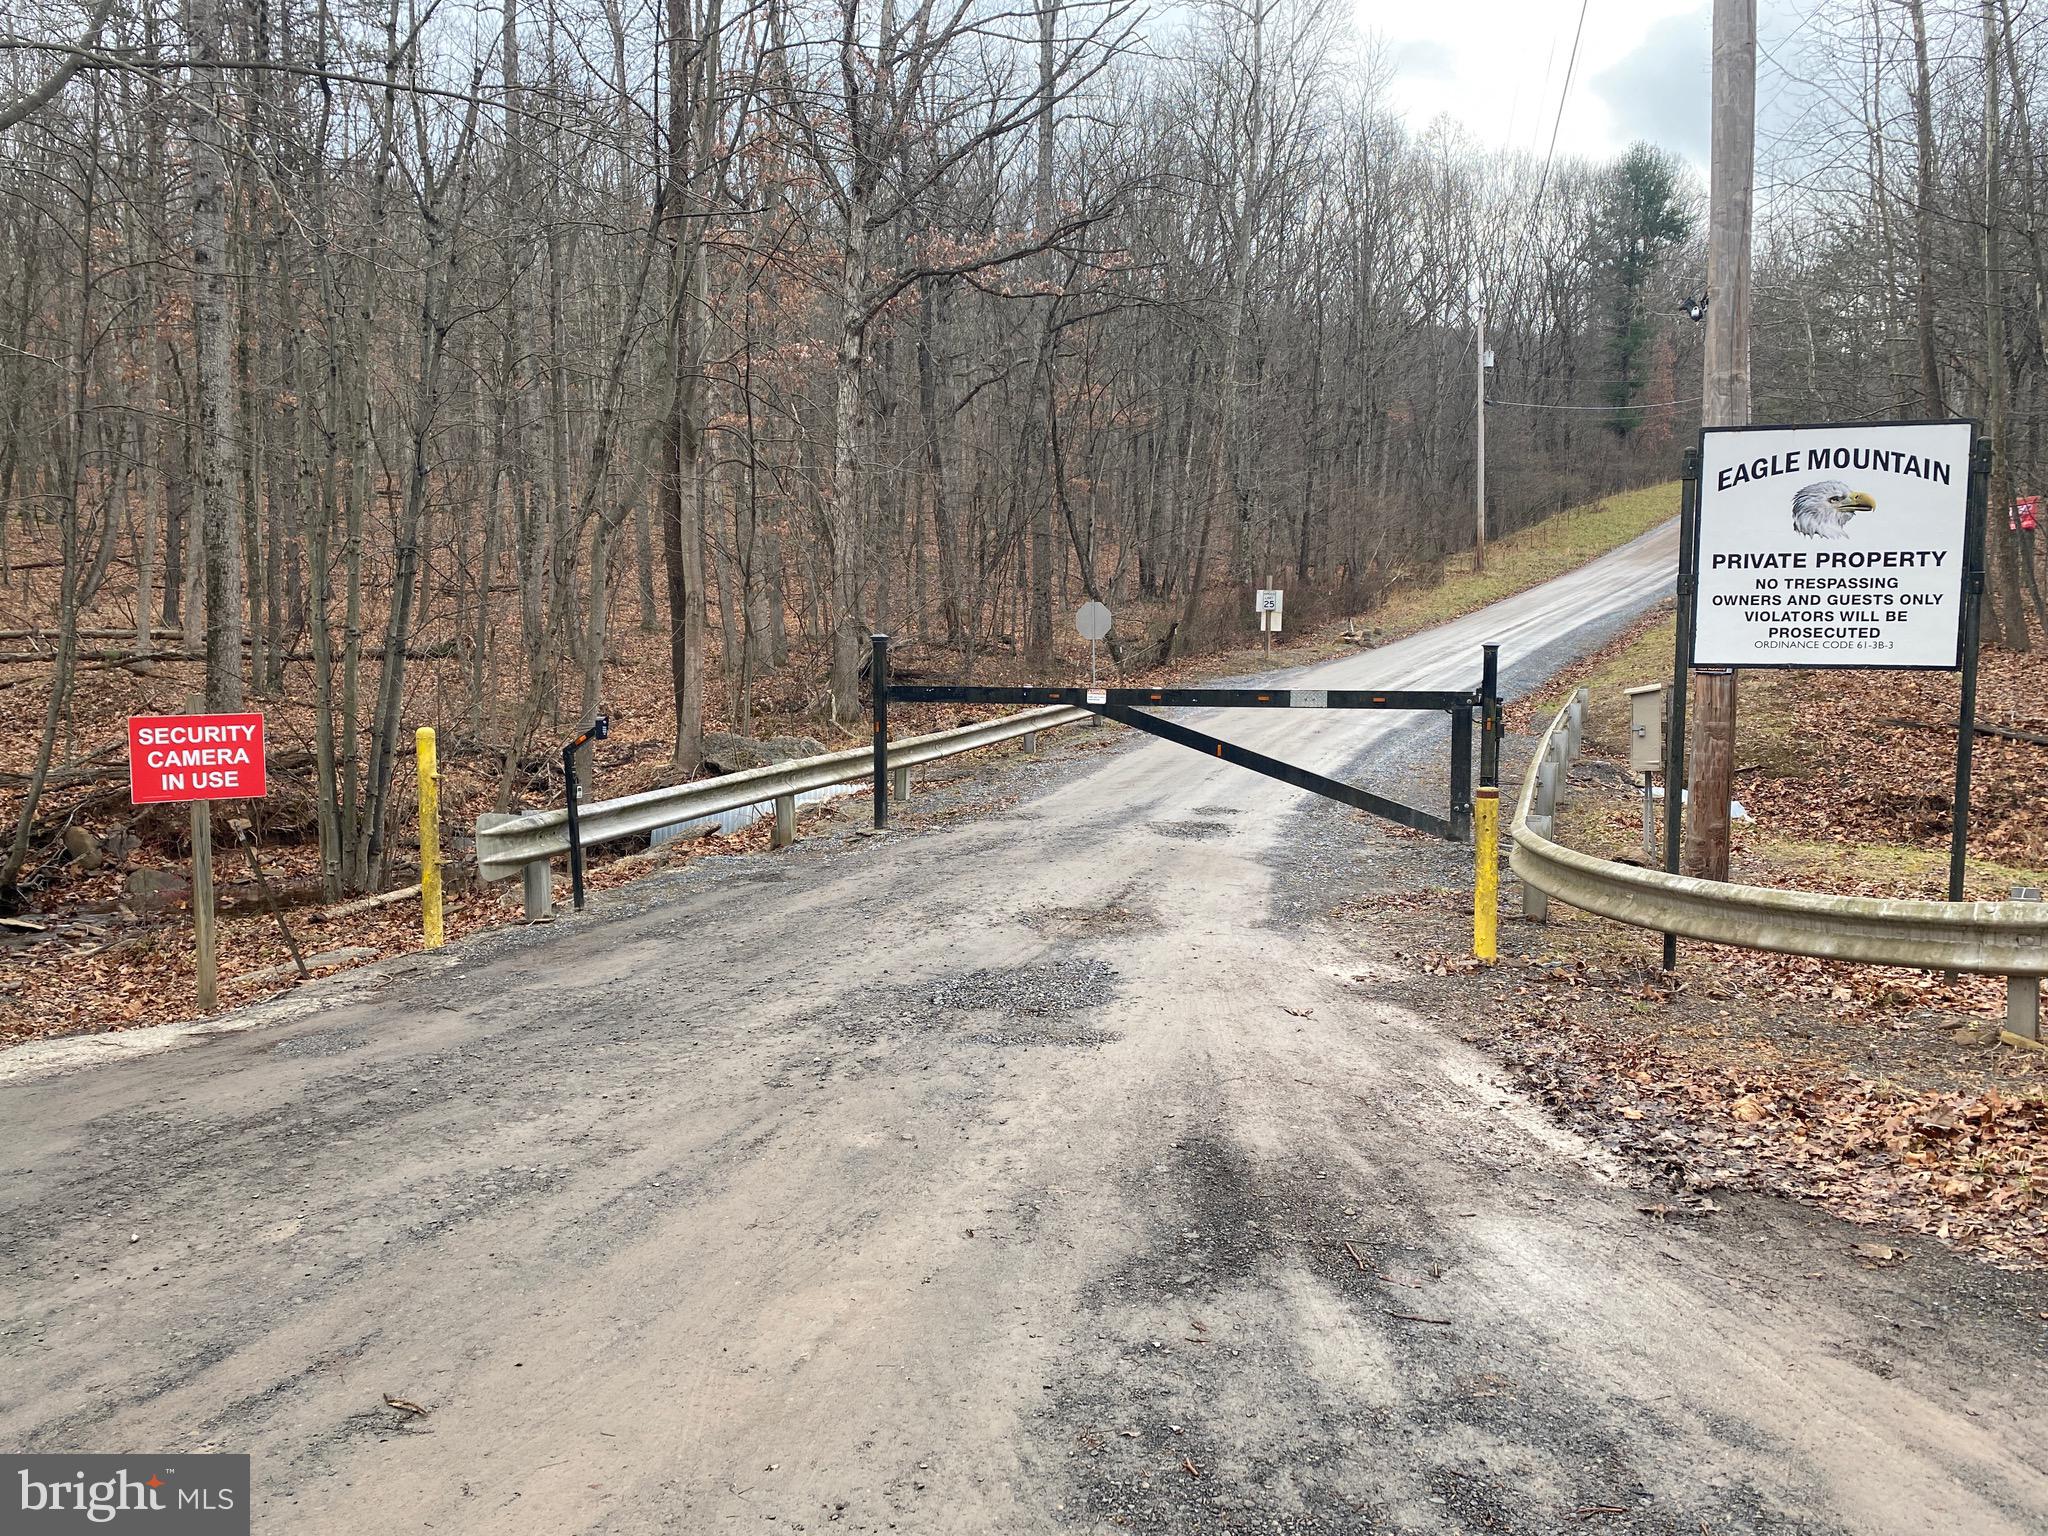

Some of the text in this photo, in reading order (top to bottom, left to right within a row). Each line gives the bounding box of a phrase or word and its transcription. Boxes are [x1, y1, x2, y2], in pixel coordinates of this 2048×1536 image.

[1717, 447, 1951, 492] EAGLE MOUNTAIN
[1712, 551, 1948, 569] PRIVATE PROPERTY
[1755, 577, 1899, 590] NO TRESPASSING
[1263, 600, 1275, 608] 25
[1712, 594, 1944, 606] OWNERS AND GUESTS ONLY
[1744, 610, 1908, 622] VIOLATORS WILL BE
[1769, 627, 1881, 639] PROSECUTED
[1754, 640, 1894, 649] ORDINANCE CODE 61-3B-3
[138, 725, 256, 746] SECURITY
[147, 747, 250, 769] CAMERA
[162, 771, 239, 791] IN USE
